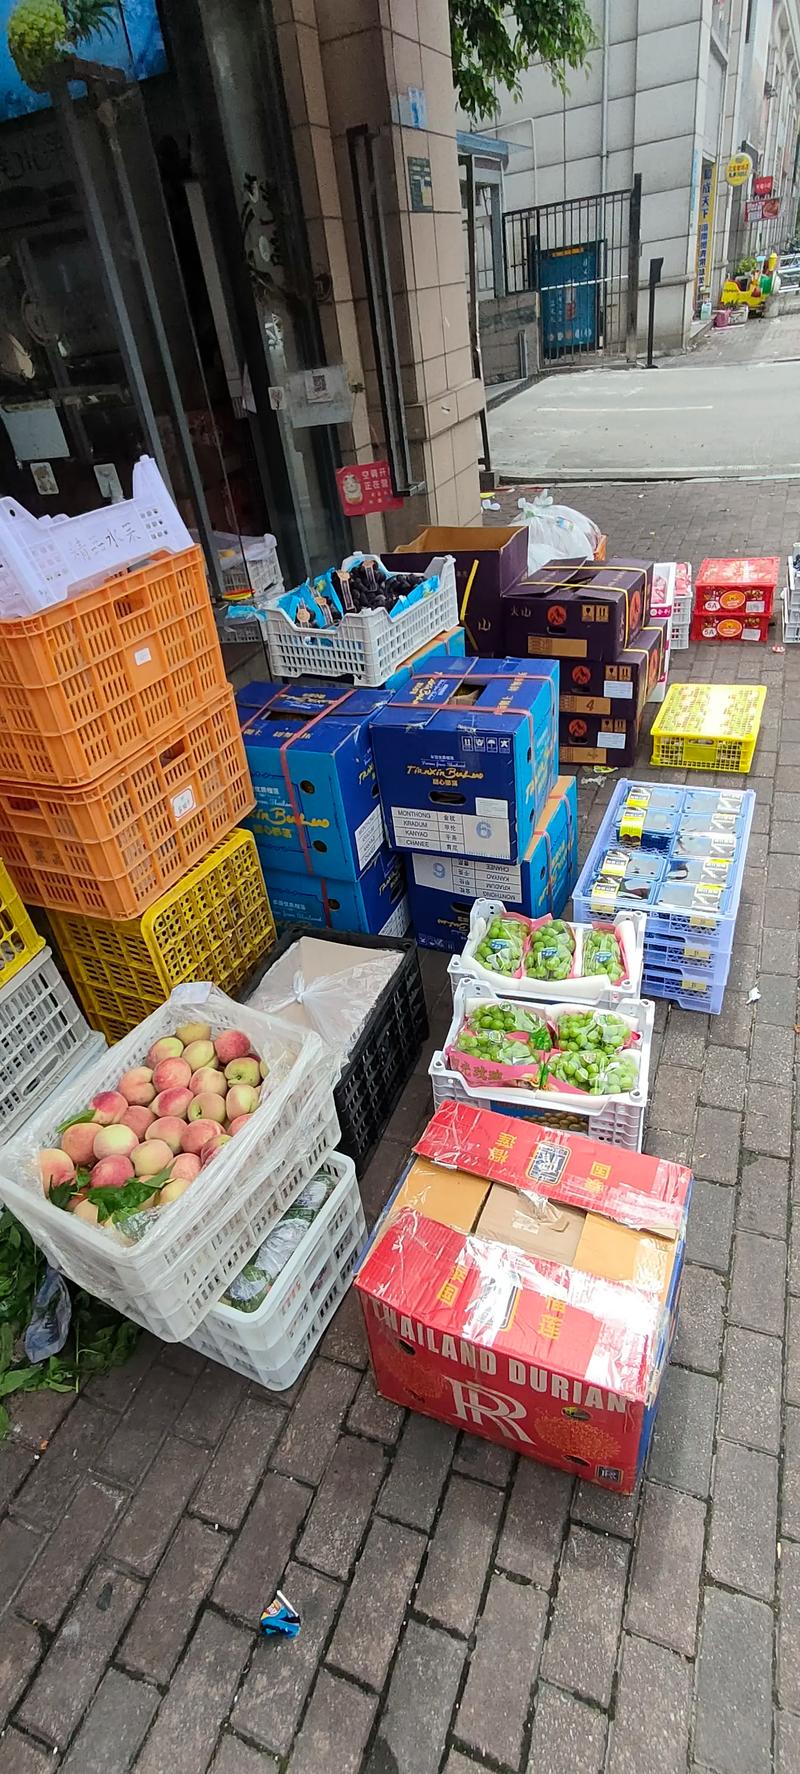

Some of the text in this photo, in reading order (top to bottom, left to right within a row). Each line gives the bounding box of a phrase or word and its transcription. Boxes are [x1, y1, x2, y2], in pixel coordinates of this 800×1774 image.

[397, 810, 431, 819] MONTHONG
[403, 820, 428, 828] KRADUM
[404, 830, 428, 838] KANYAO
[405, 839, 430, 848] CHANEE
[372, 1300, 627, 1413] THAILAND DURIAN
